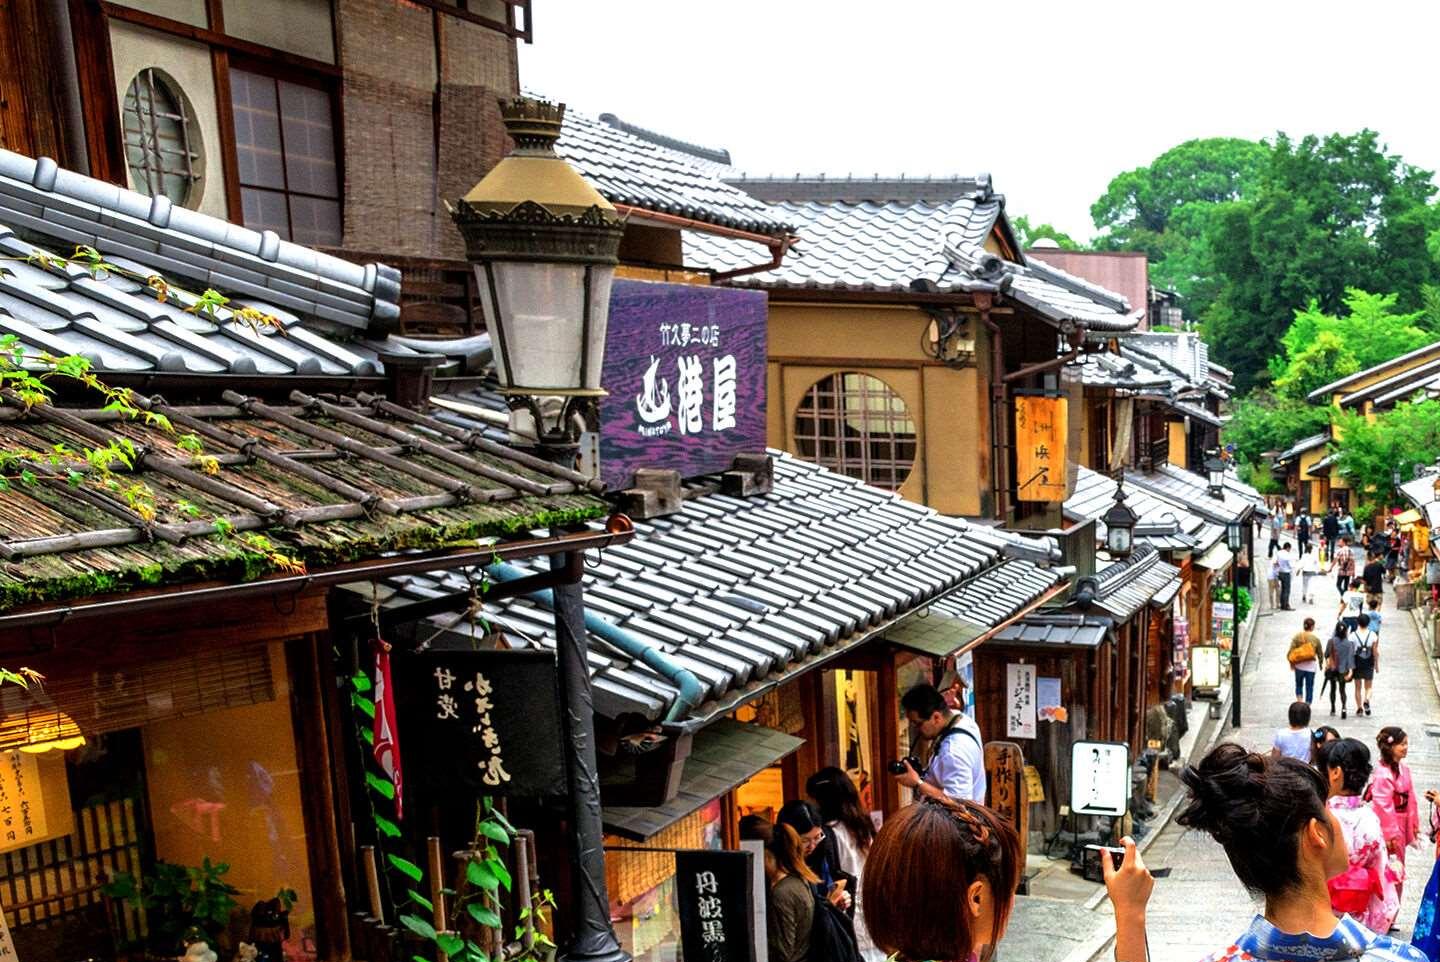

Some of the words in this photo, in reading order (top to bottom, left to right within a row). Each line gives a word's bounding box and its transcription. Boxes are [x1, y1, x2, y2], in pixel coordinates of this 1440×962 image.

[659, 322, 720, 347] 竹久夢二の店
[677, 354, 737, 436] 港屋
